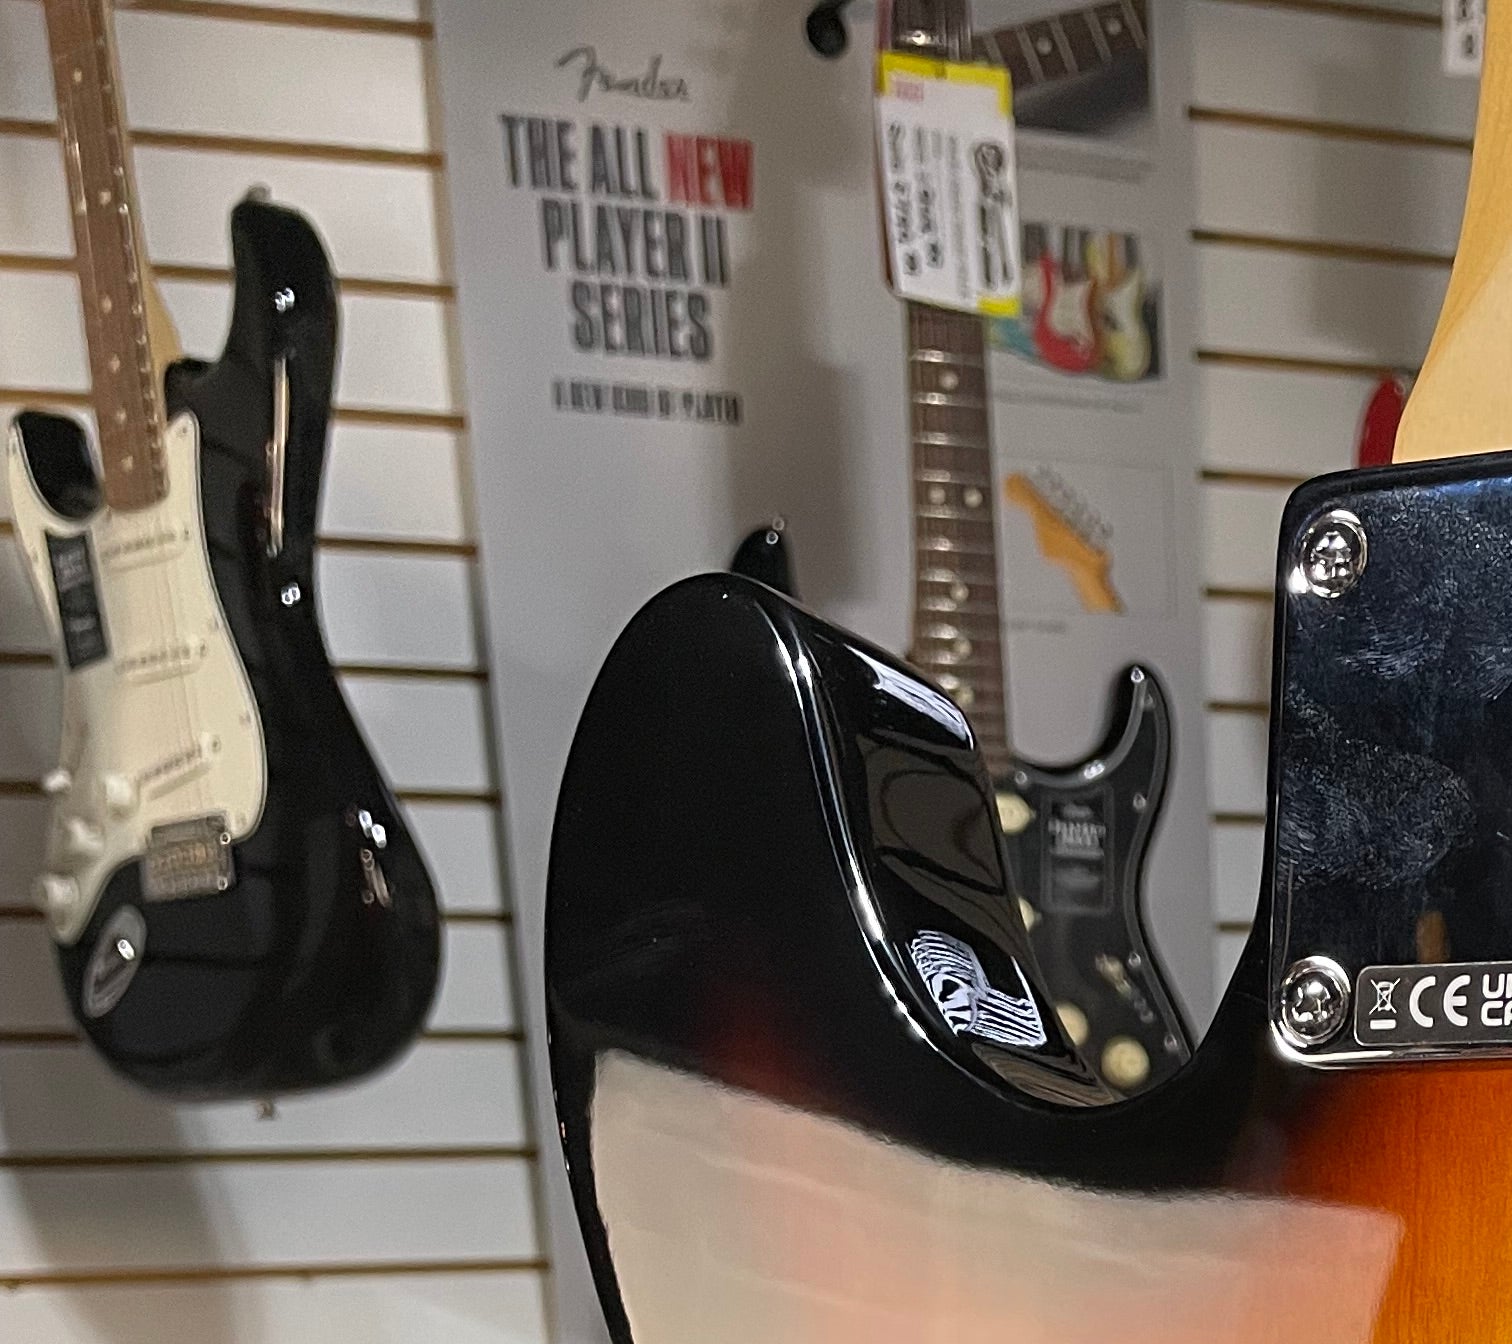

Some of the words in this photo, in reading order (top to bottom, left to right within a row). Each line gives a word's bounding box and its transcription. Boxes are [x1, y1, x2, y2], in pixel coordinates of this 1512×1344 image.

[557, 46, 691, 102] Fender
[501, 114, 577, 191] THE
[590, 124, 660, 201] ALL
[664, 133, 754, 210] NEW
[541, 198, 690, 282] PLAYER
[701, 214, 728, 287] II
[571, 280, 713, 361] SERIES
[1409, 974, 1471, 1028] CE
